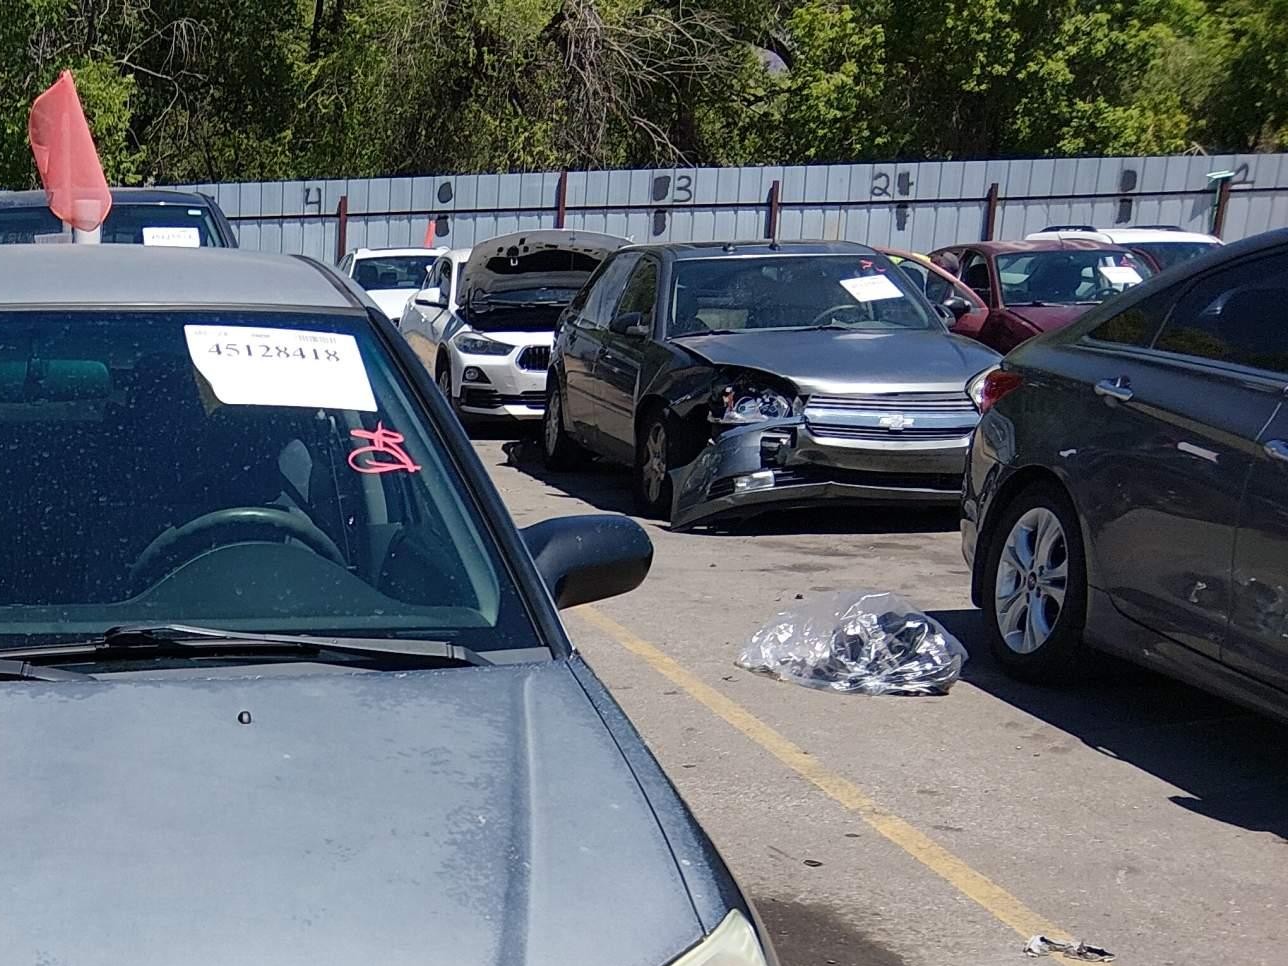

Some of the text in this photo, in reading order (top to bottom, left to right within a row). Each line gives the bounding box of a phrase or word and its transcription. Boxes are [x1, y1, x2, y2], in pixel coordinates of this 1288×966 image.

[672, 175, 692, 202] 3
[872, 172, 891, 197] 2
[305, 188, 321, 214] 4
[208, 344, 340, 361] 45128418
